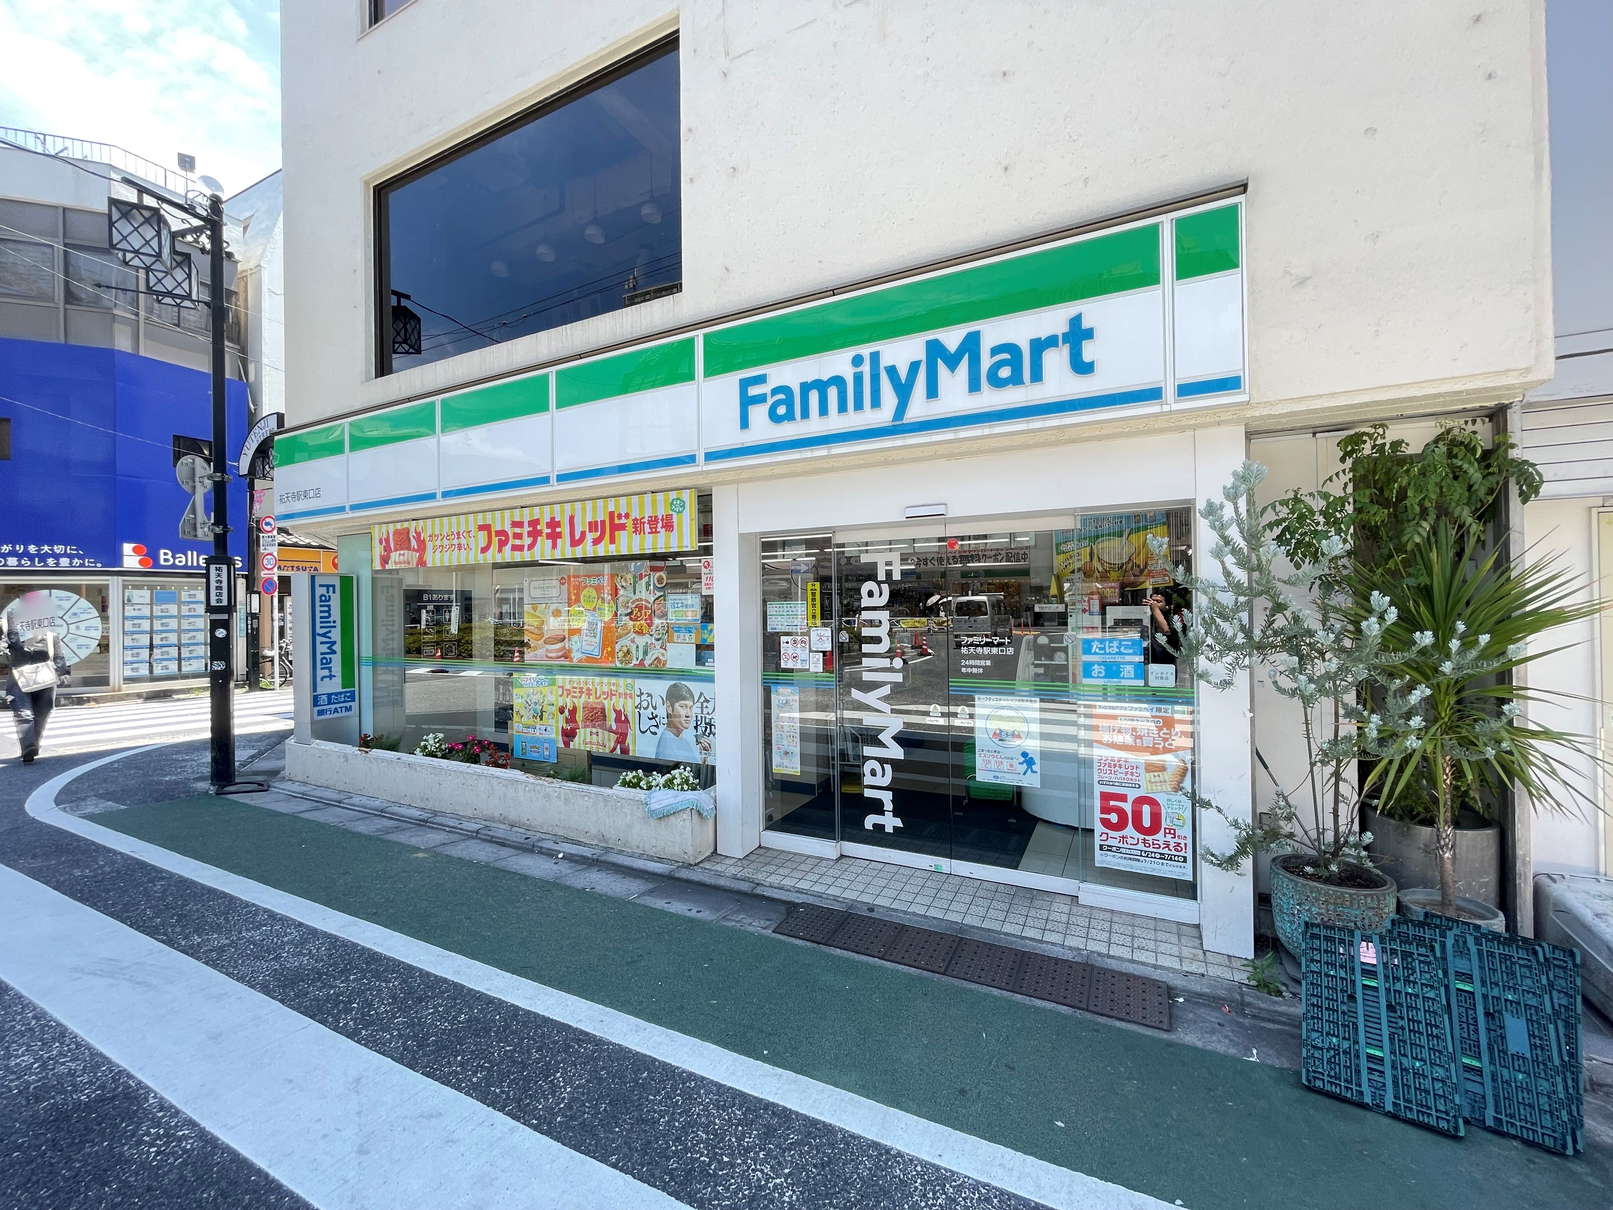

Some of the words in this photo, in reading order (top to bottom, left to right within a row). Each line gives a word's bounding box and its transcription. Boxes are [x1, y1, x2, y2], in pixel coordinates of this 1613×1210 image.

[739, 312, 1095, 430] FamilyMart
[477, 510, 630, 555] ファミチキレッド
[631, 513, 675, 535] 新登場
[160, 549, 243, 568] Balles
[316, 583, 337, 682] FamilyMart
[960, 636, 1011, 645] ファミリーマート
[1091, 640, 1134, 654] たばこ
[851, 551, 905, 834] FamilyMart
[317, 705, 352, 717] 銀行ATM
